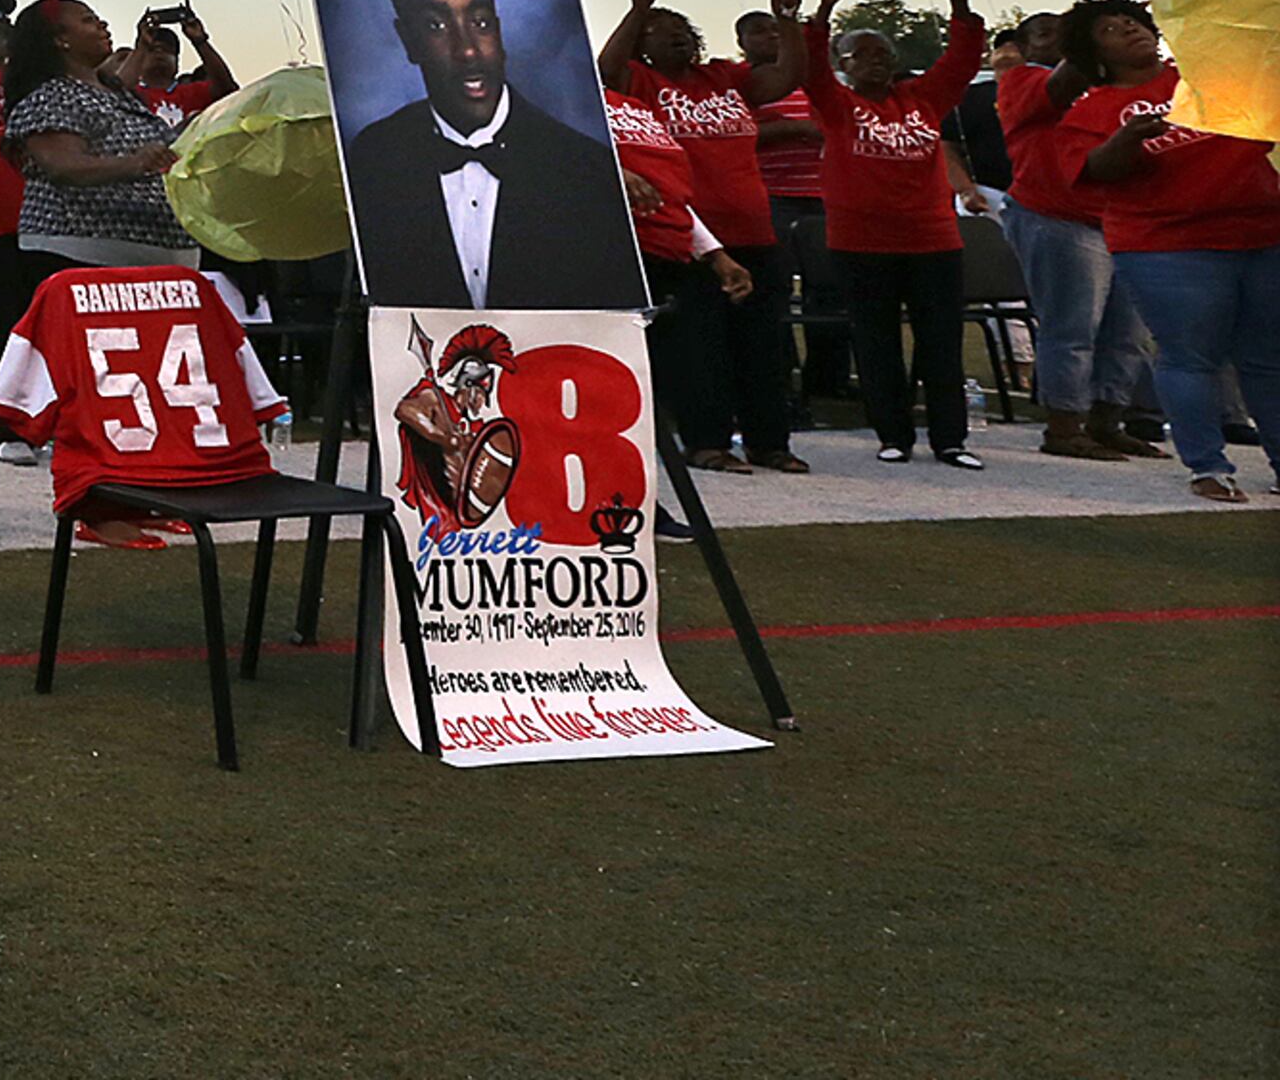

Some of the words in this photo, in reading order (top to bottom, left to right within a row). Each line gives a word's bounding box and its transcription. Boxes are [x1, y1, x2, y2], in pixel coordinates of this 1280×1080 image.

[69, 279, 202, 314] BANNEKER
[85, 323, 230, 452] 54
[496, 344, 647, 547] 8
[416, 515, 544, 571] Jerrett
[410, 556, 648, 612] MUMFORD
[492, 671, 526, 695] are
[530, 696, 609, 742] live
